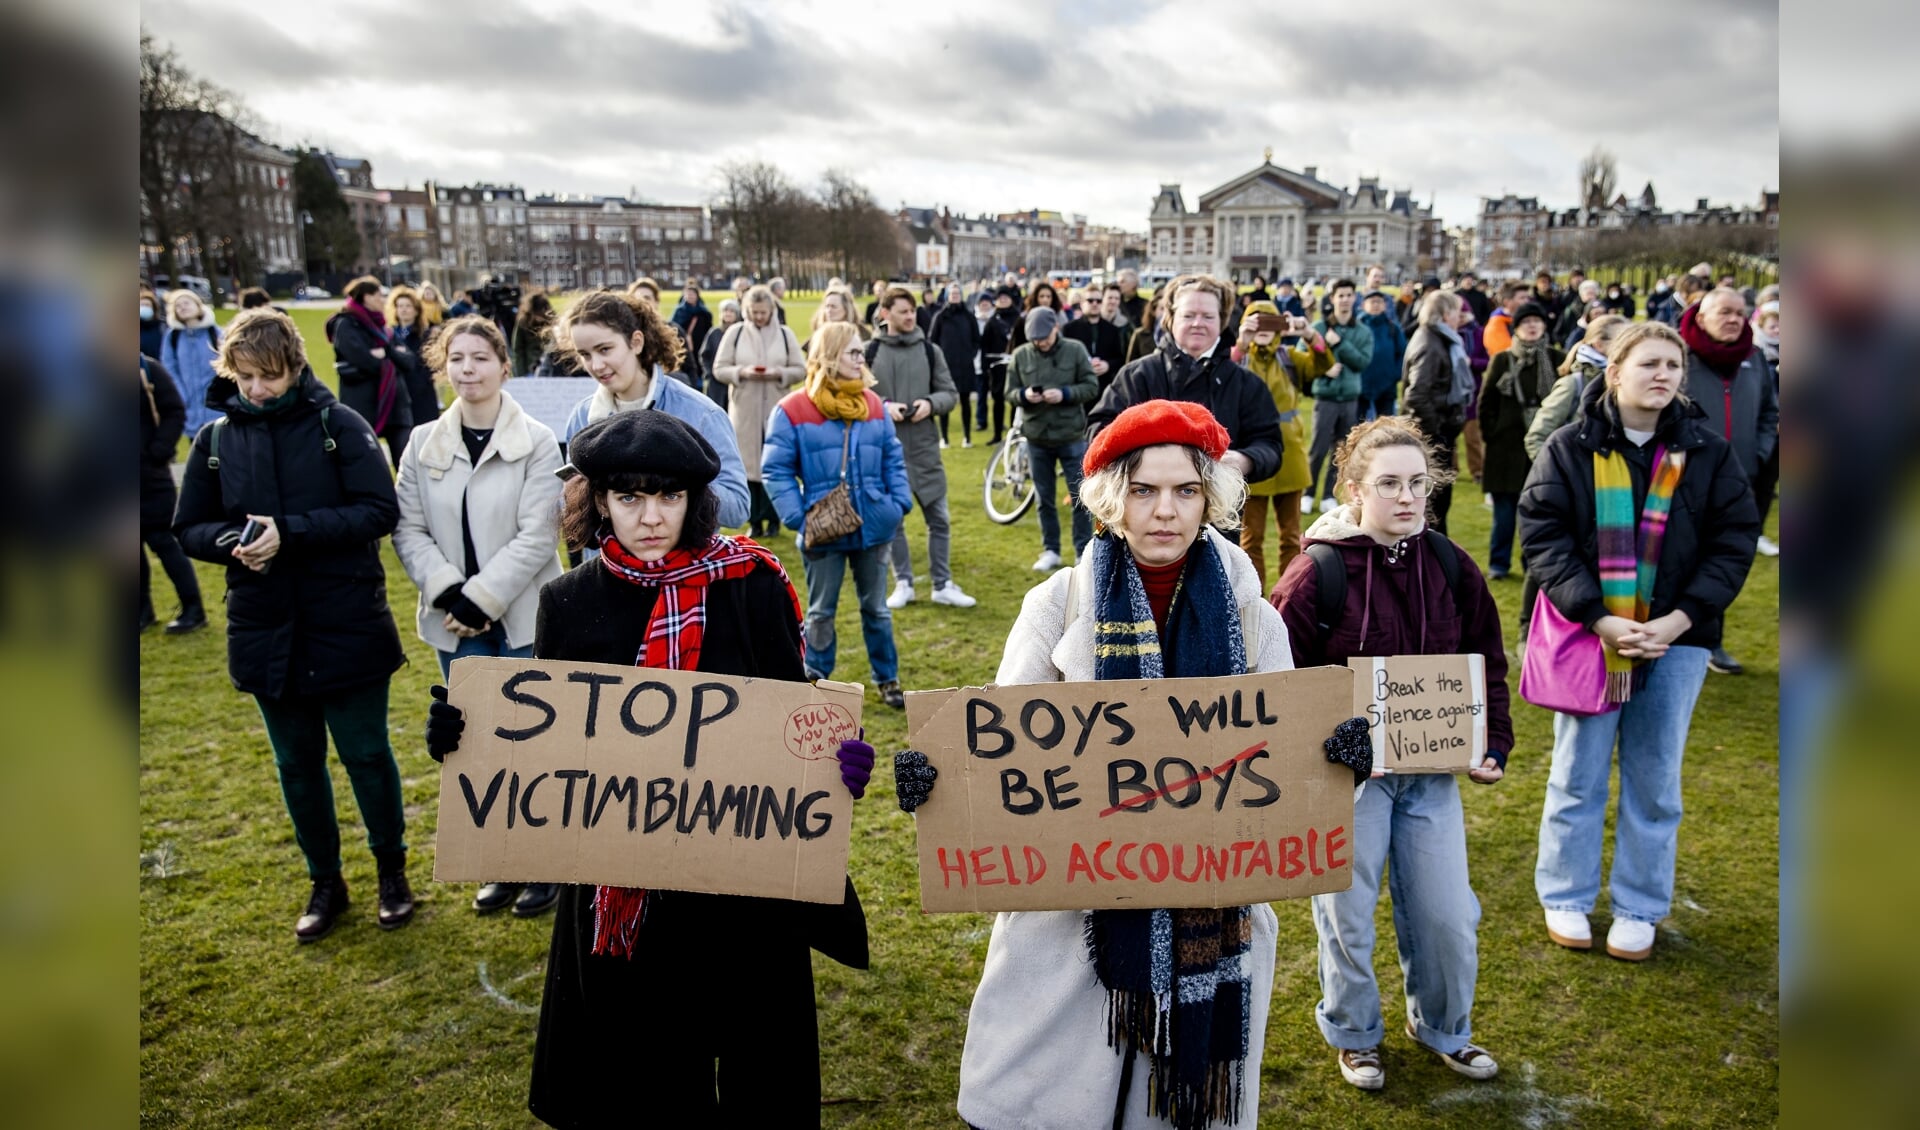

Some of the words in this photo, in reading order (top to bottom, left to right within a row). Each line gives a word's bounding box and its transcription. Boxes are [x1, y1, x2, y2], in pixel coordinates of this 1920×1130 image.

[1366, 704, 1433, 728] Silence
[1437, 699, 1484, 728] against
[1436, 672, 1463, 693] the
[495, 669, 739, 769] STOP
[793, 706, 839, 731] FUCK
[966, 698, 1135, 759] BOYS
[1167, 689, 1278, 738] WILL
[1388, 729, 1465, 761] Violence
[458, 768, 833, 841] VICTIMBLAMING
[1000, 765, 1082, 815] BE
[1107, 748, 1280, 812] BOYS
[937, 845, 1047, 889] HELD
[1066, 826, 1348, 884] ACCOUNTABLE
